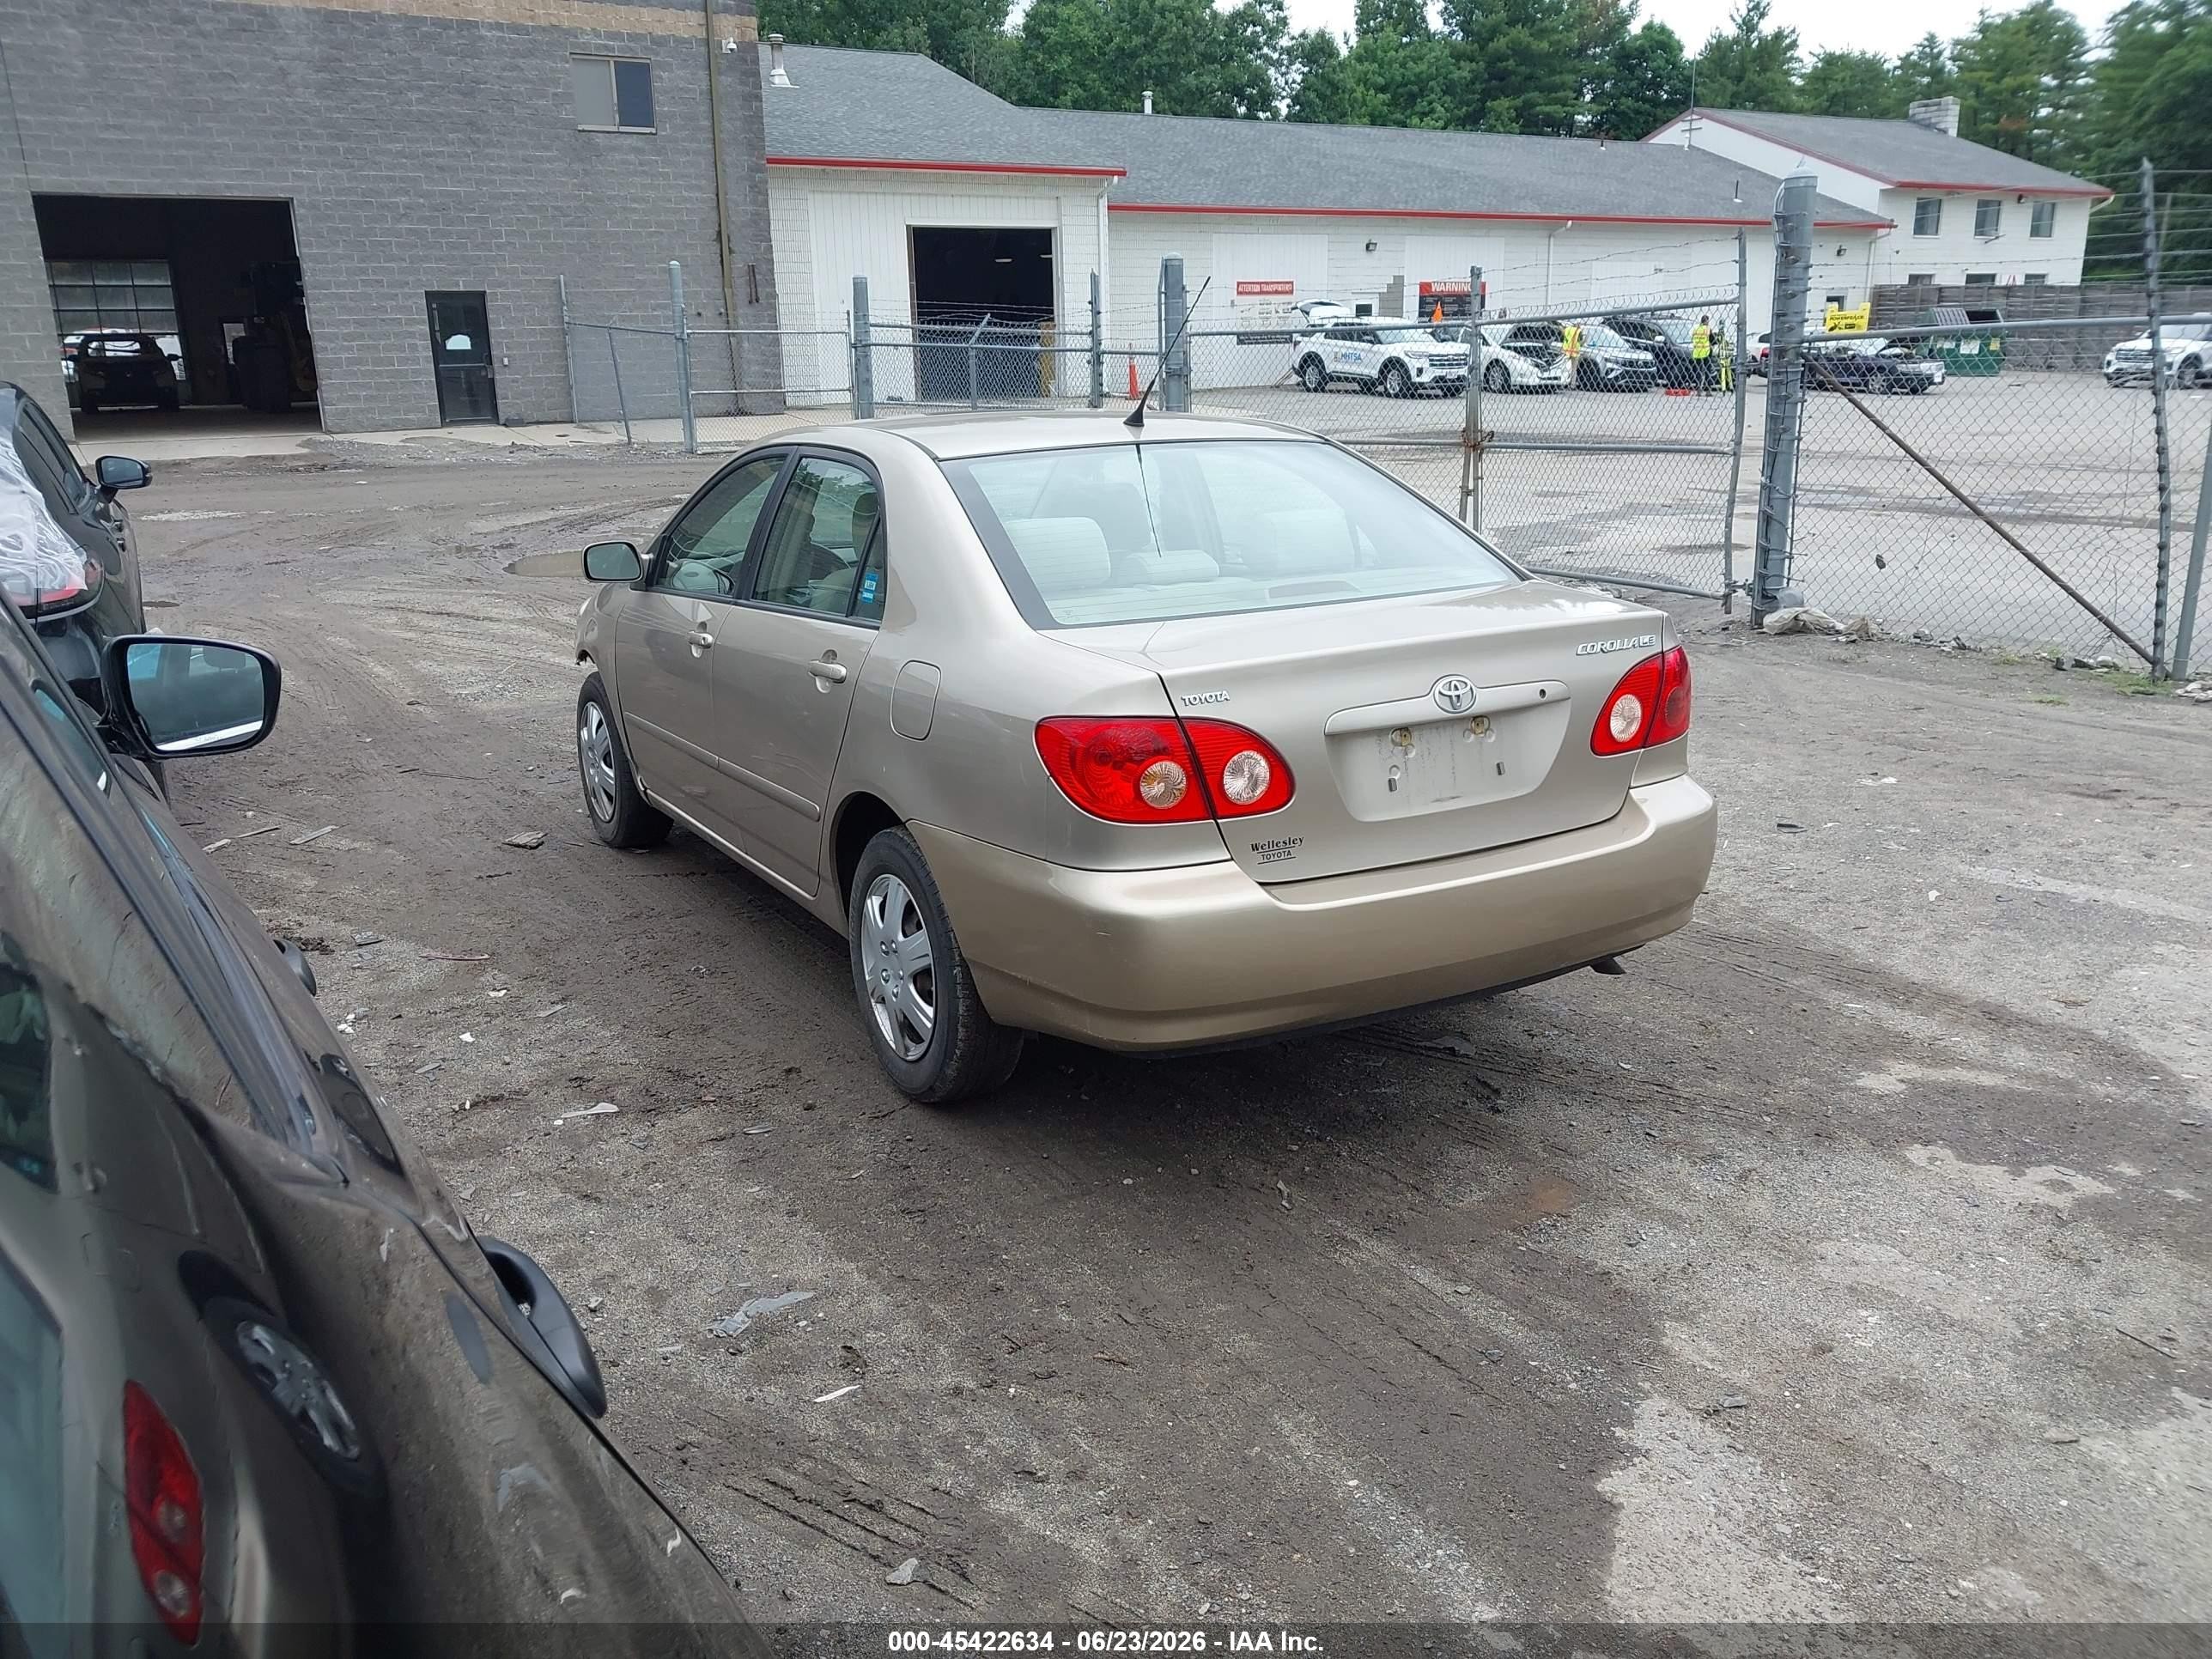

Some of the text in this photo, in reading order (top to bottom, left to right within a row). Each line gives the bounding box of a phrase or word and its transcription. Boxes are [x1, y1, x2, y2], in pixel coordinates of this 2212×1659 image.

[1576, 635, 1656, 655] COROLLA LE
[1182, 690, 1230, 706] TOYOTA
[1250, 836, 1304, 852] Wellesley
[1261, 849, 1291, 860] TOYOTA
